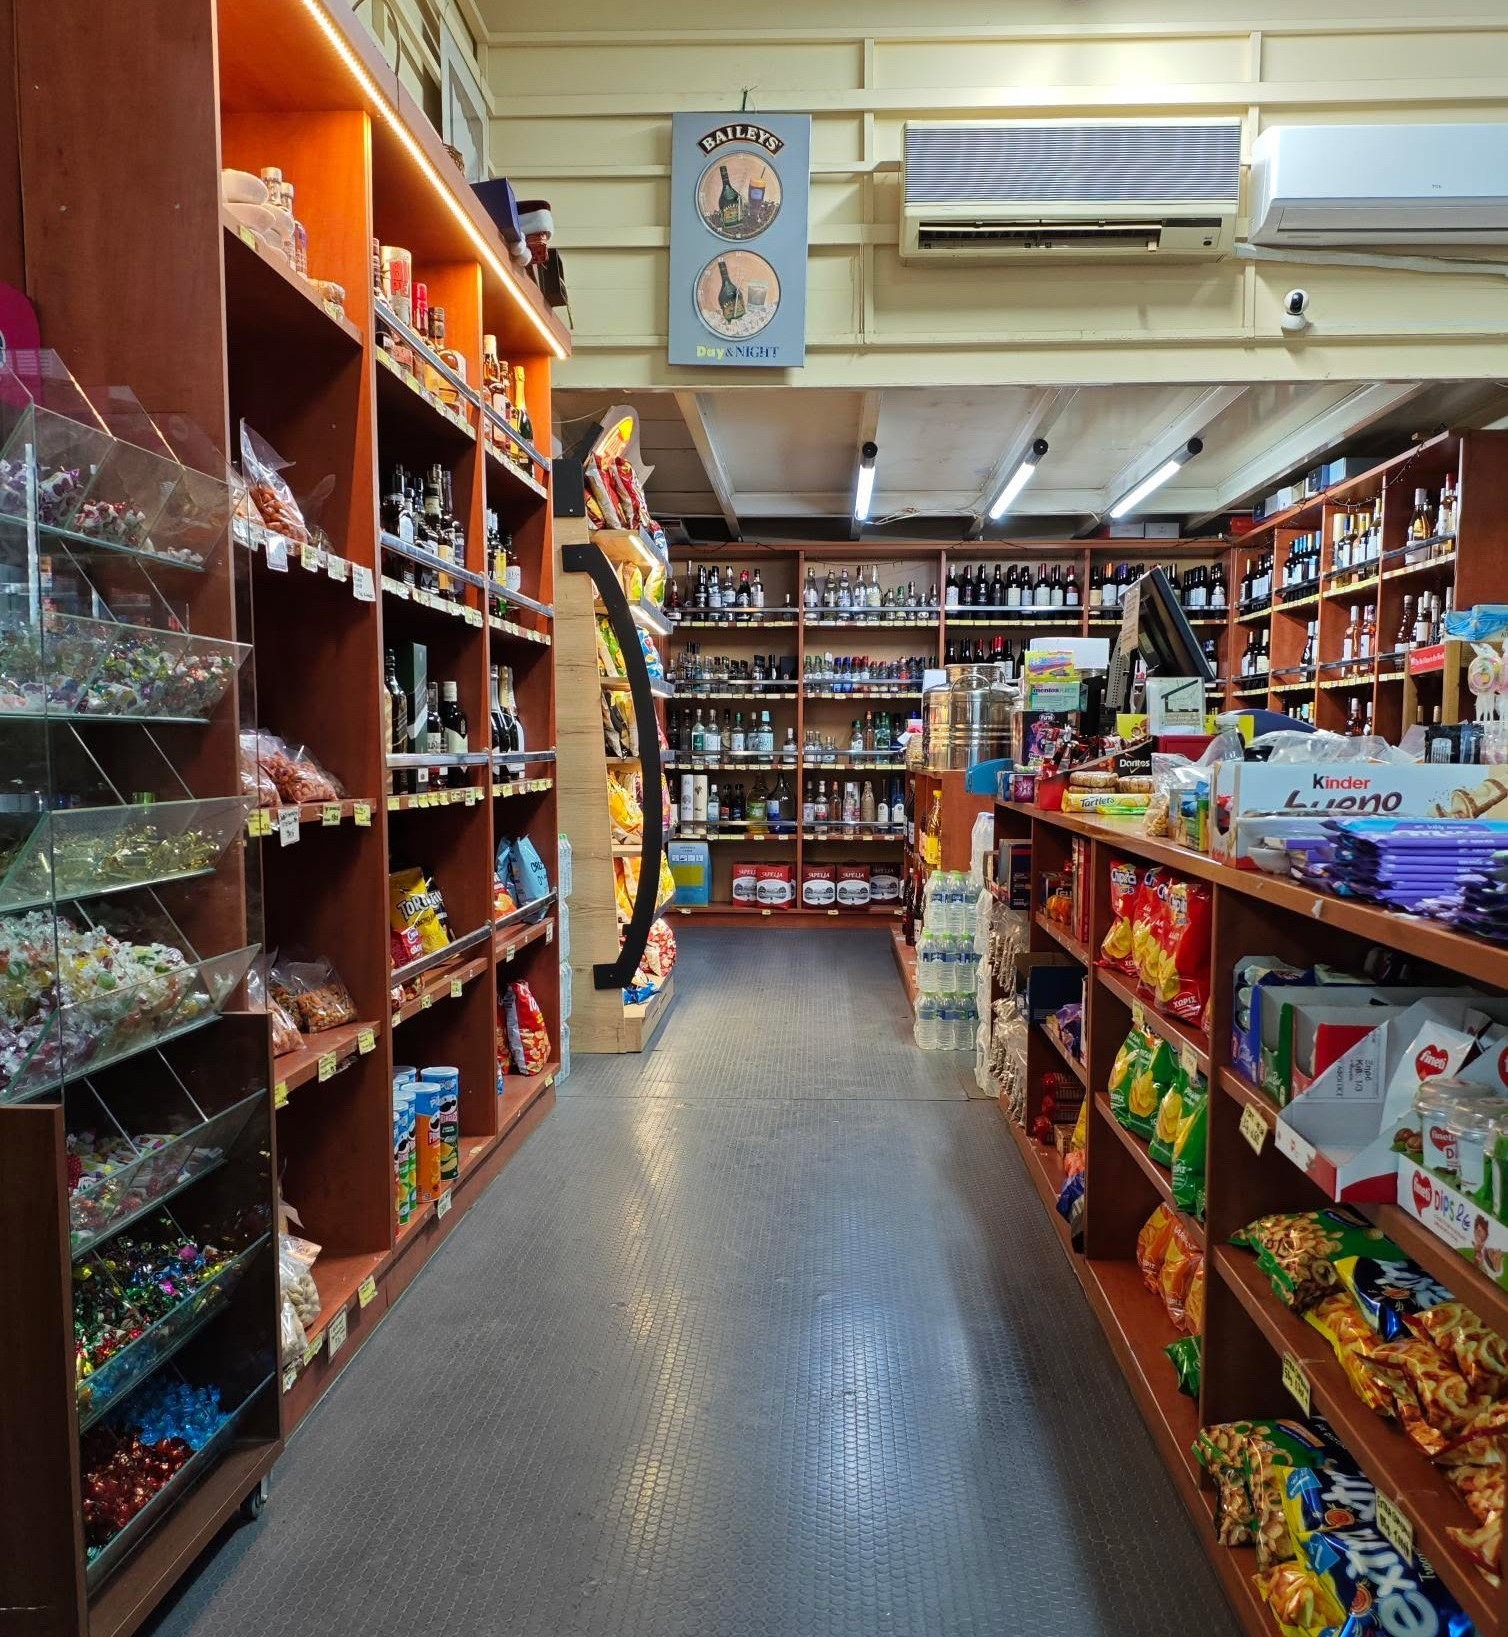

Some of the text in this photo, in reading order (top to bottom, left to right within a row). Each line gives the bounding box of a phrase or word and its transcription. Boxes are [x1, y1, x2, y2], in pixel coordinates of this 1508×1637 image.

[701, 126, 780, 152] BAILEYS
[1119, 759, 1151, 768] Doritos
[1312, 773, 1371, 790] Kinder
[1080, 796, 1115, 808] Tartlets
[1172, 994, 1198, 1008] ΧΩΡΙΣ
[1420, 1051, 1447, 1070] fineti
